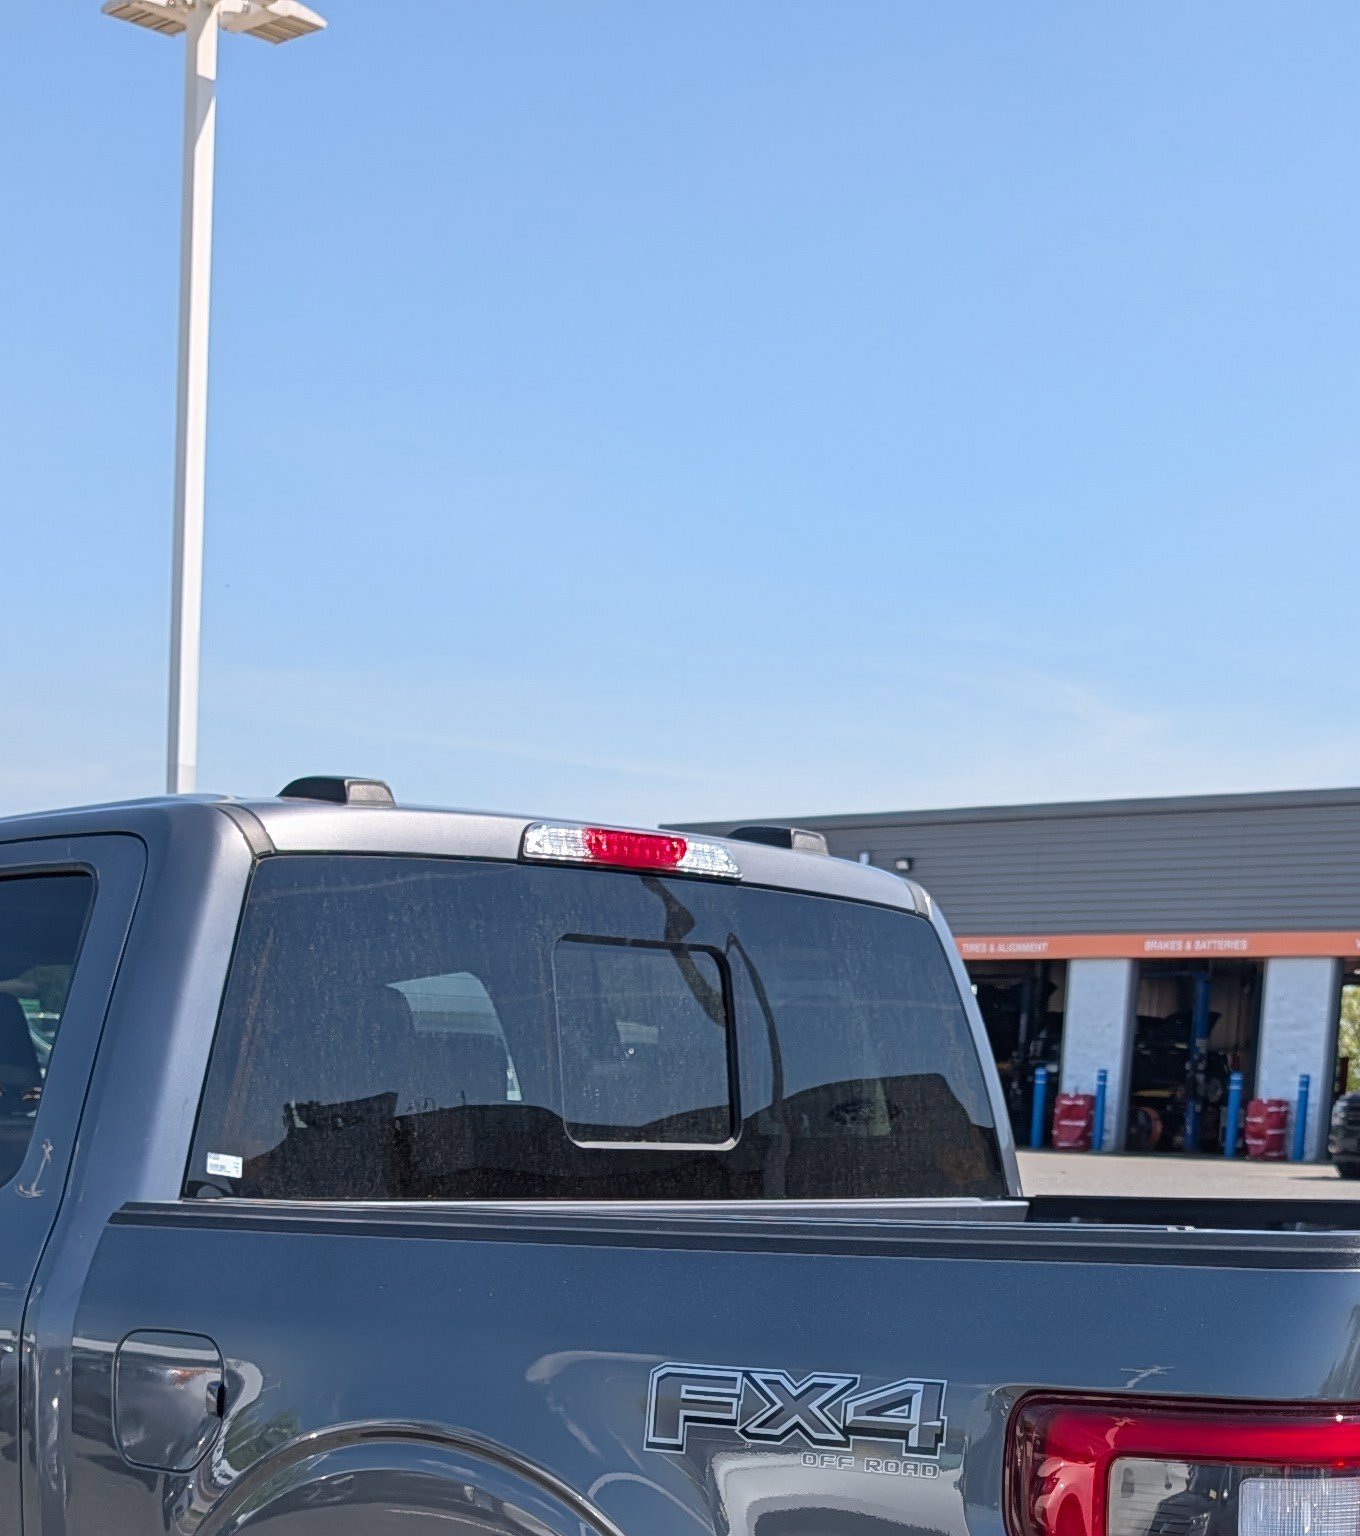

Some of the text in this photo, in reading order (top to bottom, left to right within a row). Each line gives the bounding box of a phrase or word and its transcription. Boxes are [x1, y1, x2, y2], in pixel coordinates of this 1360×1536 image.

[1144, 940, 1183, 951] BRAKES
[1194, 939, 1248, 951] BATTERIES
[643, 1362, 947, 1459] FX4
[801, 1453, 940, 1479] OFF ROAD
